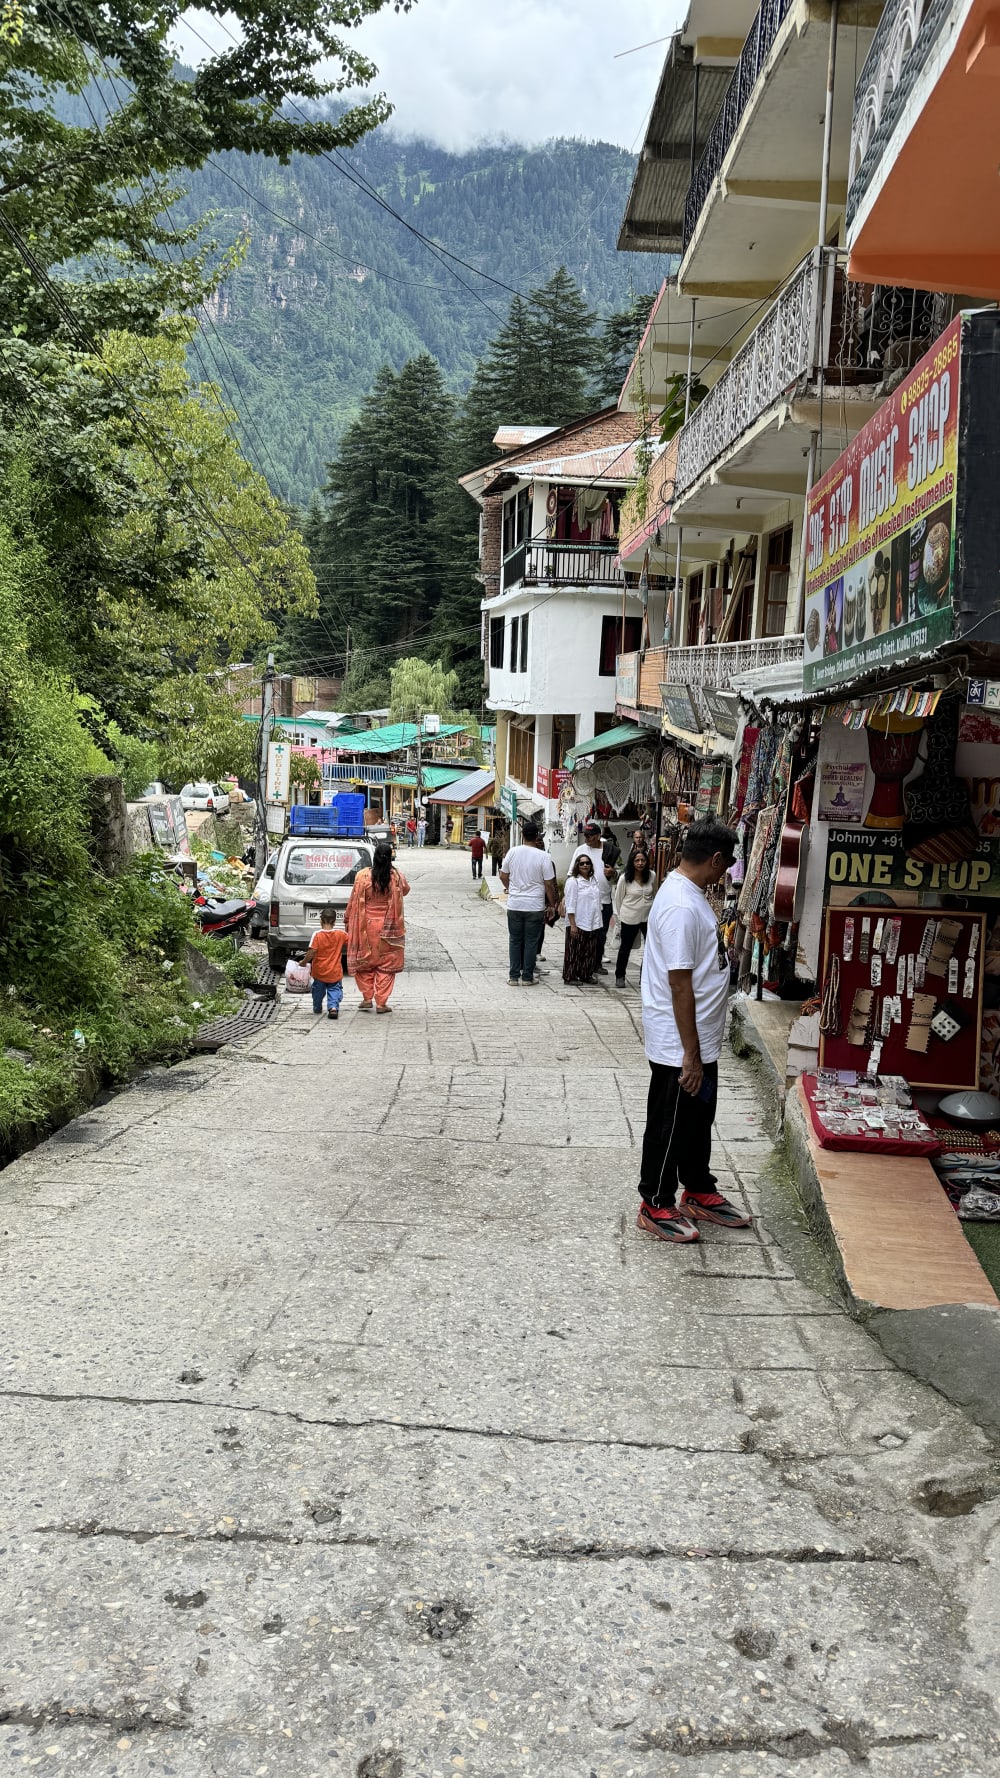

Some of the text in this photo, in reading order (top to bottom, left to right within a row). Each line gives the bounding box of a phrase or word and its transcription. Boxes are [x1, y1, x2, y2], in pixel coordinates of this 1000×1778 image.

[808, 504, 825, 574] ONE
[829, 474, 853, 557] STOP
[859, 425, 899, 532] MUSIC
[907, 371, 951, 491] SHOP
[879, 509, 903, 543] Musical
[904, 472, 954, 524] Instruments
[866, 643, 882, 661] Manali,
[275, 754, 283, 790] MEDICINE
[829, 831, 877, 847] Johnny
[828, 851, 991, 891] ONE STOP
